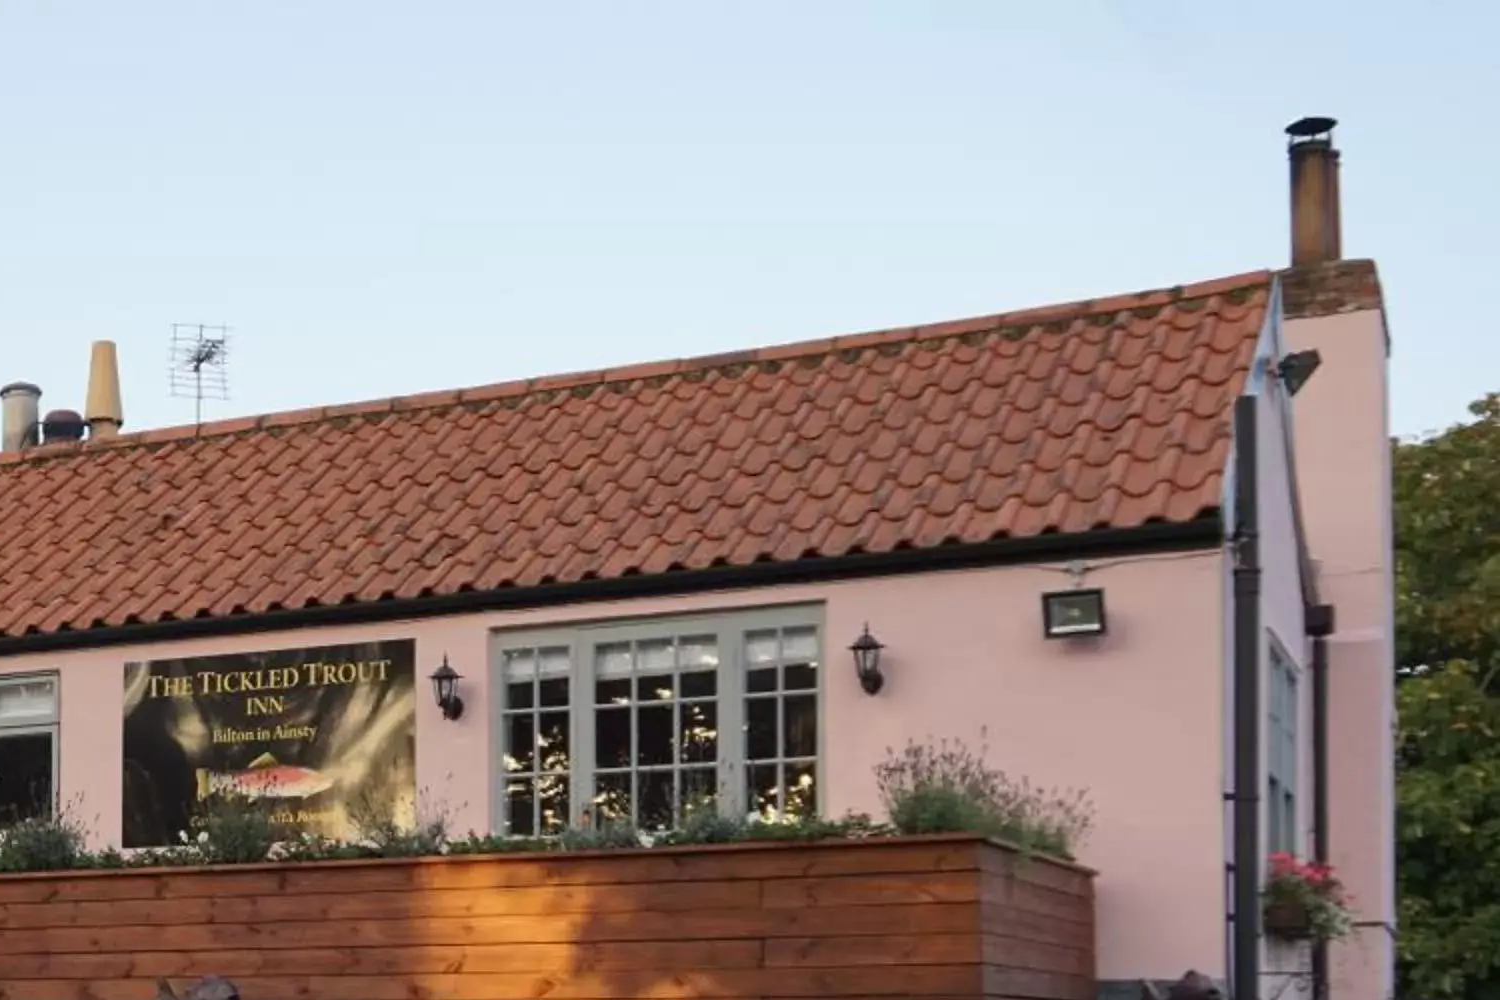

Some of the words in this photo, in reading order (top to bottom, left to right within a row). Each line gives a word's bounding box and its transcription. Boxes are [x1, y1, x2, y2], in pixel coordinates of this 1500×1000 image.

[150, 675, 193, 697] THE
[197, 668, 298, 694] TICKLED
[303, 660, 391, 686] TROUT
[247, 697, 284, 715] INN
[213, 728, 254, 743] Bilton
[257, 727, 271, 742] in
[274, 724, 317, 743] Ainsty
